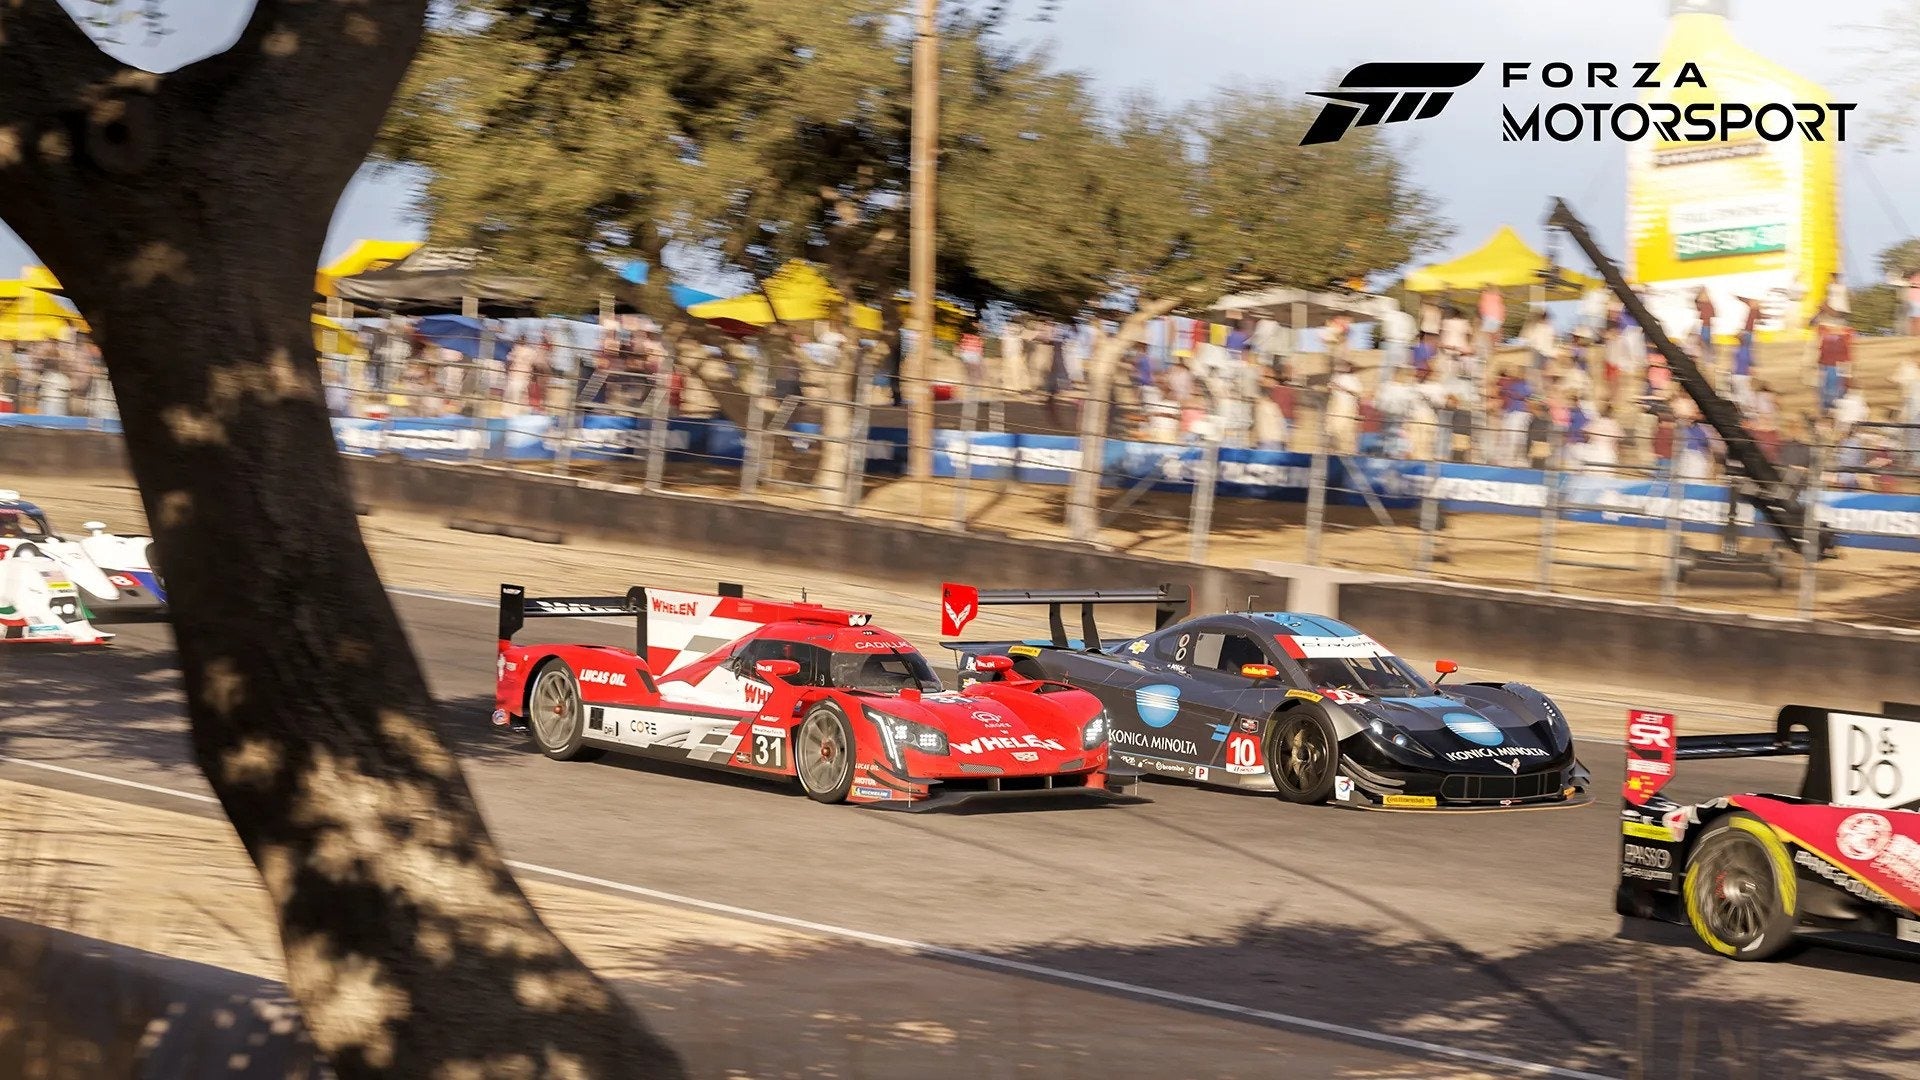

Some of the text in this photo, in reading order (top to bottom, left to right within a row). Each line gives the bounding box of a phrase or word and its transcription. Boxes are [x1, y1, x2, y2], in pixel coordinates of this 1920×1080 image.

[652, 597, 697, 616] WHELEN
[579, 668, 627, 687] LUCAS OIL
[630, 719, 658, 736] CORE
[755, 735, 782, 767] 31
[949, 734, 1067, 755] WHELEN
[1108, 728, 1198, 756] KONICA MINOLTA
[1230, 736, 1257, 767] 10
[1446, 747, 1550, 761] KONICA MINOLTA
